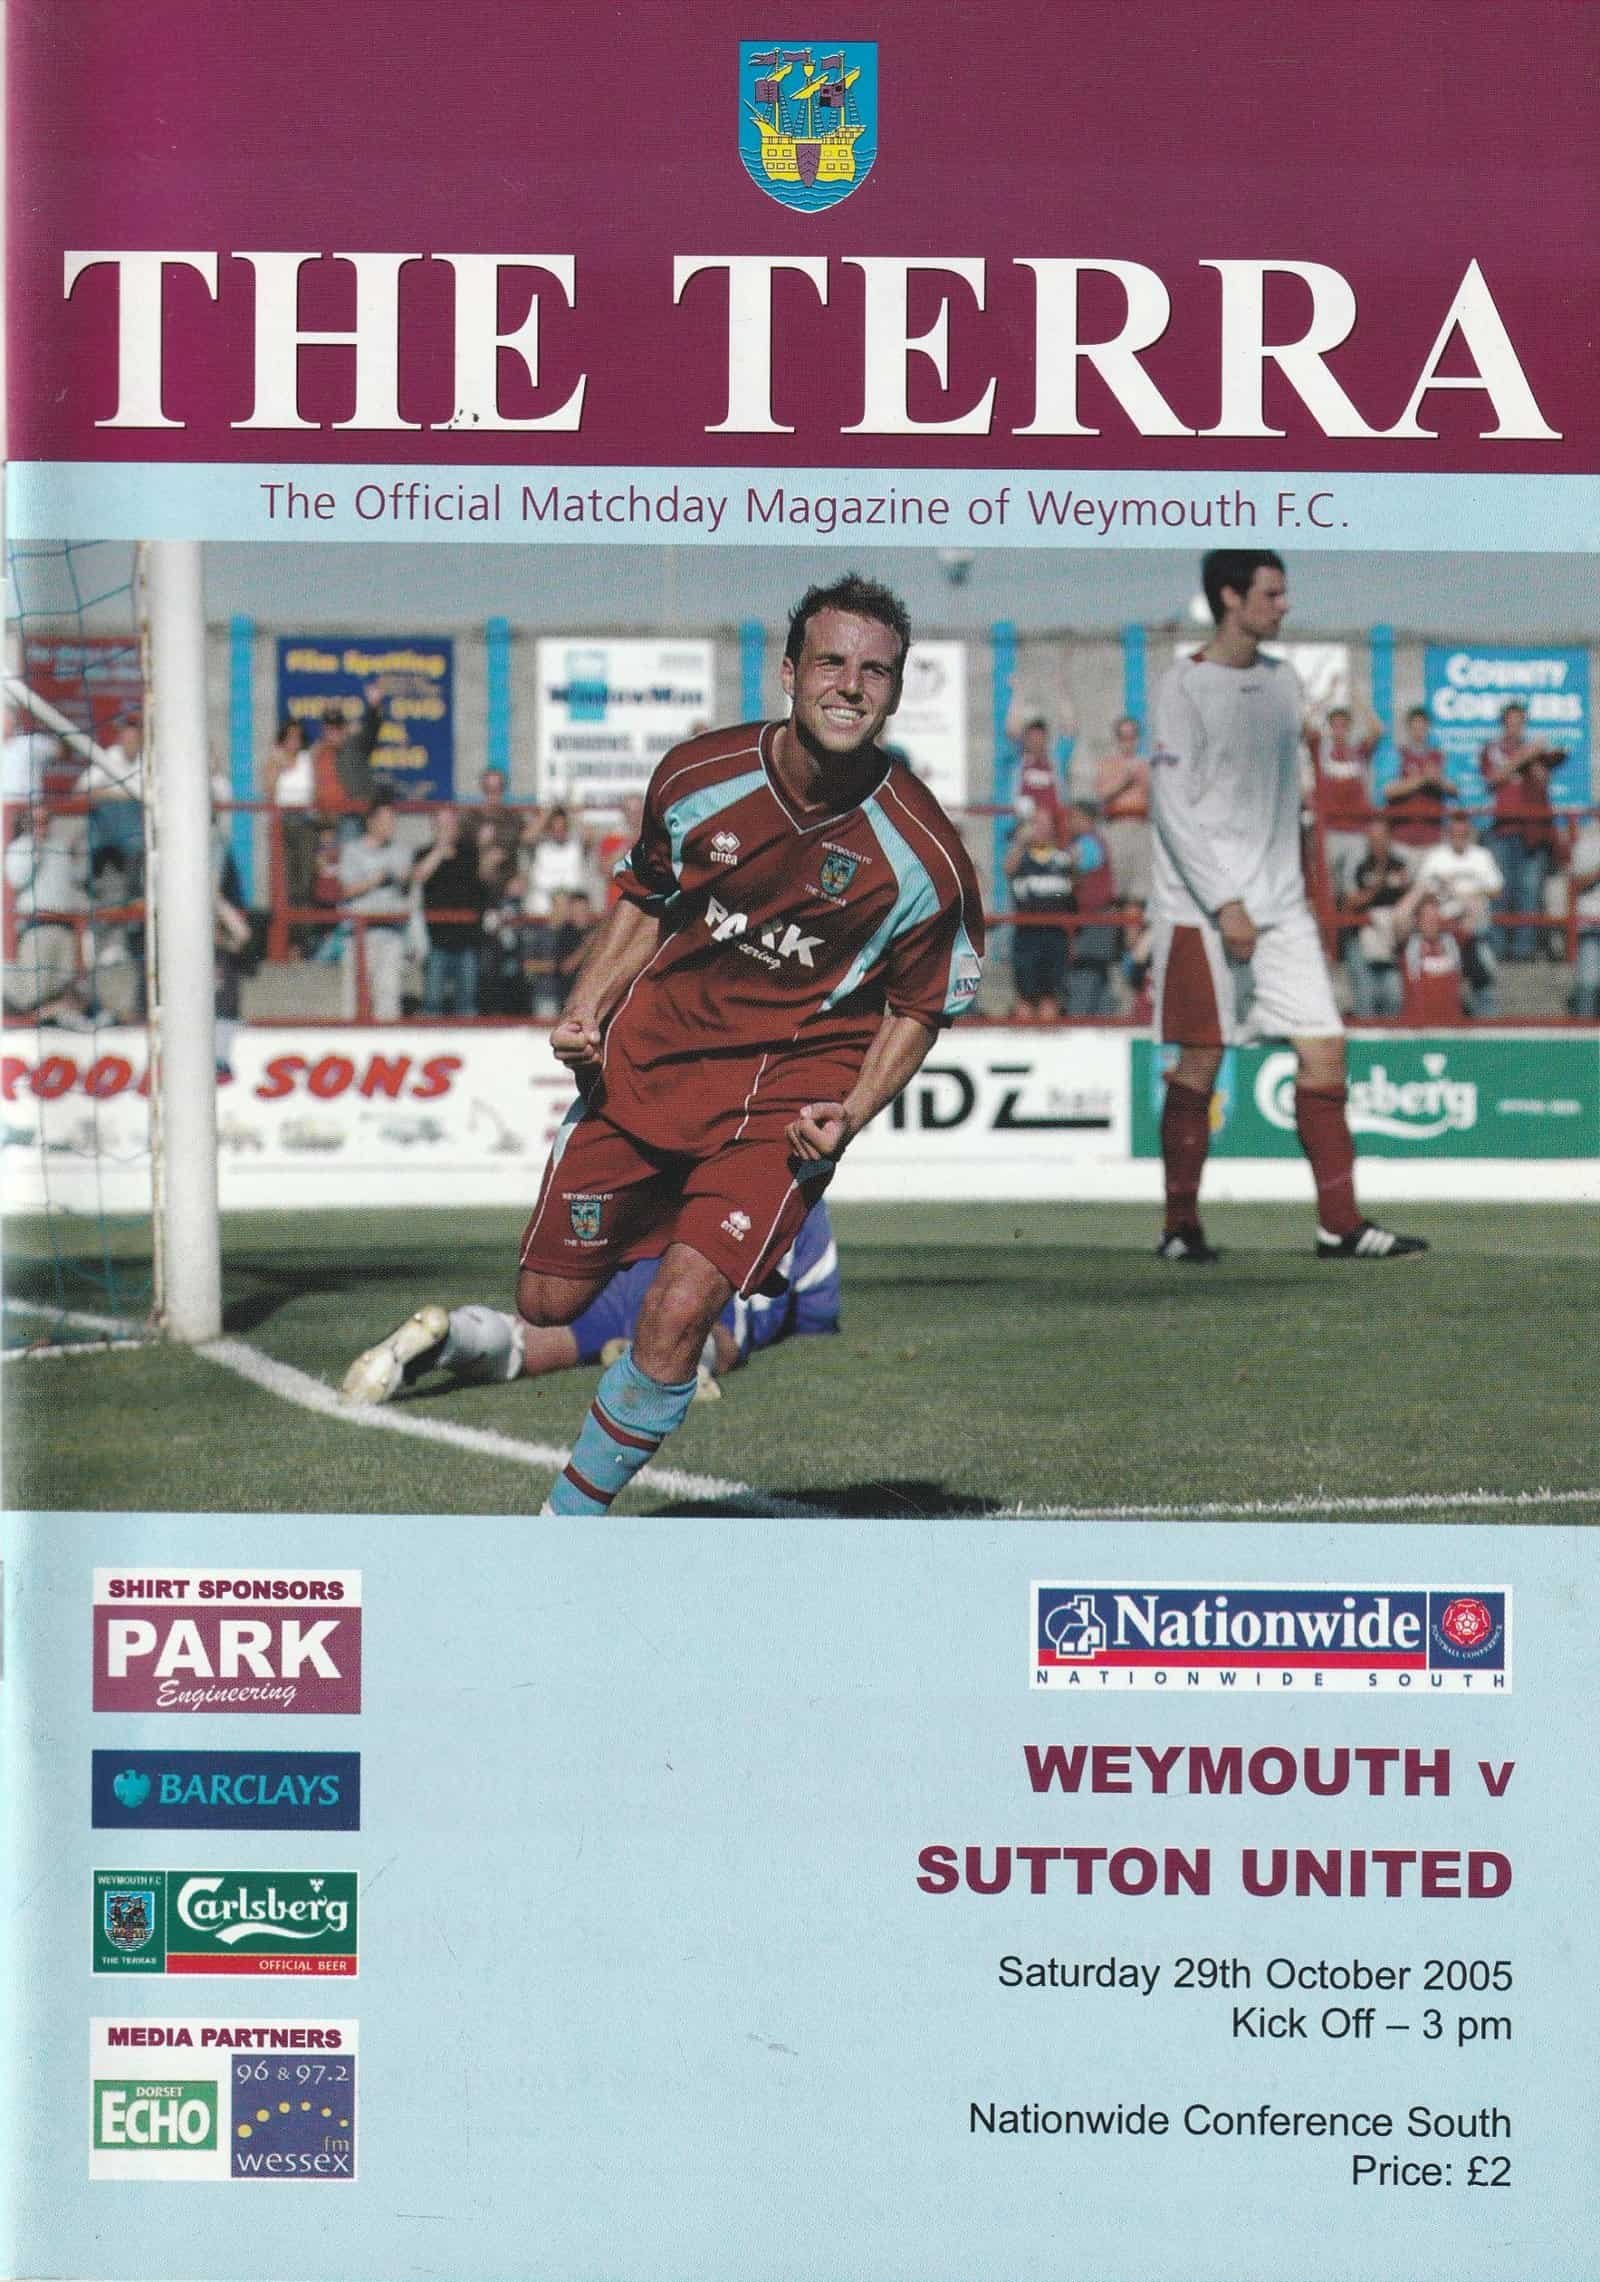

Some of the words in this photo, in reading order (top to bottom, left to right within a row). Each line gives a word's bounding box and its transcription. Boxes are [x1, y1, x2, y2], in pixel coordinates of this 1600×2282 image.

[64, 251, 588, 433] THE
[673, 256, 1564, 441] TERRA
[261, 484, 336, 520] The
[354, 484, 500, 522] Official
[522, 486, 728, 532] Matchday
[748, 487, 950, 534] Magazine
[970, 489, 1011, 527] of
[1027, 489, 1257, 537] Weymouth
[1277, 493, 1350, 529] F.C.
[255, 1055, 462, 1100] SONS
[109, 1580, 190, 1599] SHIRT
[198, 1580, 345, 1600] SPONSORS
[1112, 1596, 1421, 1648] Nationwide
[107, 1619, 342, 1679] PARK
[156, 1680, 298, 1711] Engineering
[1036, 1671, 1324, 1687] NATIONWIDE
[1368, 1673, 1505, 1689] SOUTH
[160, 1774, 340, 1806] BARCLAYS
[1024, 1745, 1451, 1797] WEYMOUTH
[1478, 1762, 1516, 1798] v
[916, 1845, 1211, 1896] SUTTON
[1242, 1849, 1513, 1899] UNITED
[177, 1877, 348, 1945] Carlsberg
[259, 1959, 312, 1971] OFFICIAL
[317, 1959, 347, 1971] BEER
[999, 1956, 1161, 1996] Saturday
[1174, 1958, 1252, 1990] 29th
[1266, 1959, 1412, 1991] October
[1424, 1961, 1513, 1992] 2005
[108, 2027, 194, 2048] MEDIA
[201, 2028, 343, 2049] PARTNERS
[1233, 2007, 1308, 2039] Kick
[1322, 2008, 1376, 2040] Off
[1423, 2009, 1444, 2040] 3
[1458, 2017, 1512, 2048] pm
[236, 2060, 269, 2084] 96
[277, 2067, 290, 2081] &
[296, 2064, 349, 2085] 97.2
[136, 2086, 184, 2098] DORSET
[101, 2090, 211, 2145] ECHO
[970, 2103, 1170, 2136] Nationwide
[1184, 2105, 1393, 2137] Conference
[1408, 2106, 1512, 2138] South
[236, 2152, 350, 2173] wessex
[1353, 2155, 1453, 2187] Price:
[1467, 2156, 1512, 2188] £2
